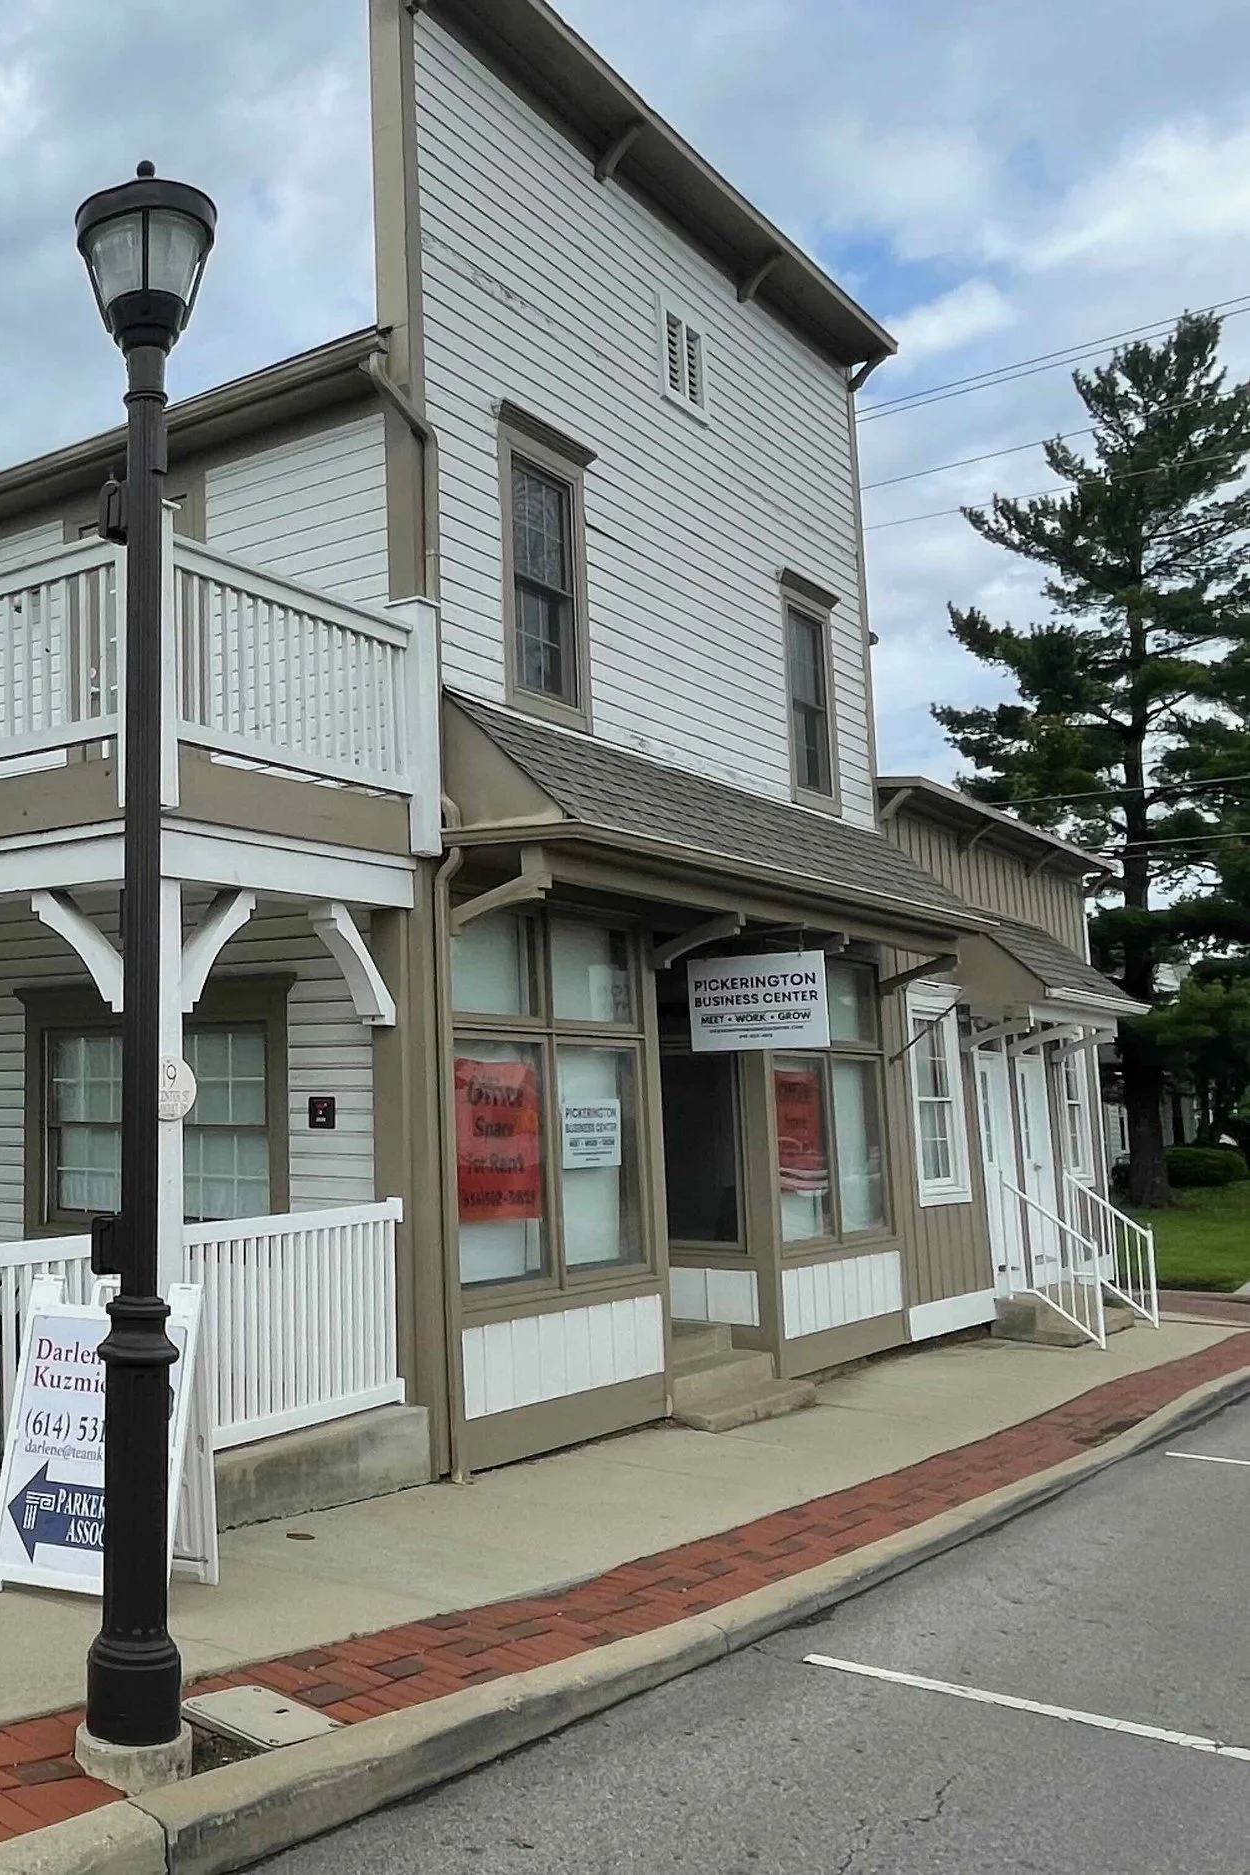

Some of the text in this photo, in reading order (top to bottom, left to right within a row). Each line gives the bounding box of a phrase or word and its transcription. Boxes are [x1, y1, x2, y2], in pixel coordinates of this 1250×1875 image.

[694, 972, 816, 992] PICKERINGTON
[694, 990, 818, 1008] BUSINESS CENTER
[701, 1011, 811, 1025] MEET WORK GROW
[36, 1338, 102, 1365] Darlen
[25, 1408, 70, 1441] (614)
[25, 1438, 103, 1461] darlene@teamk
